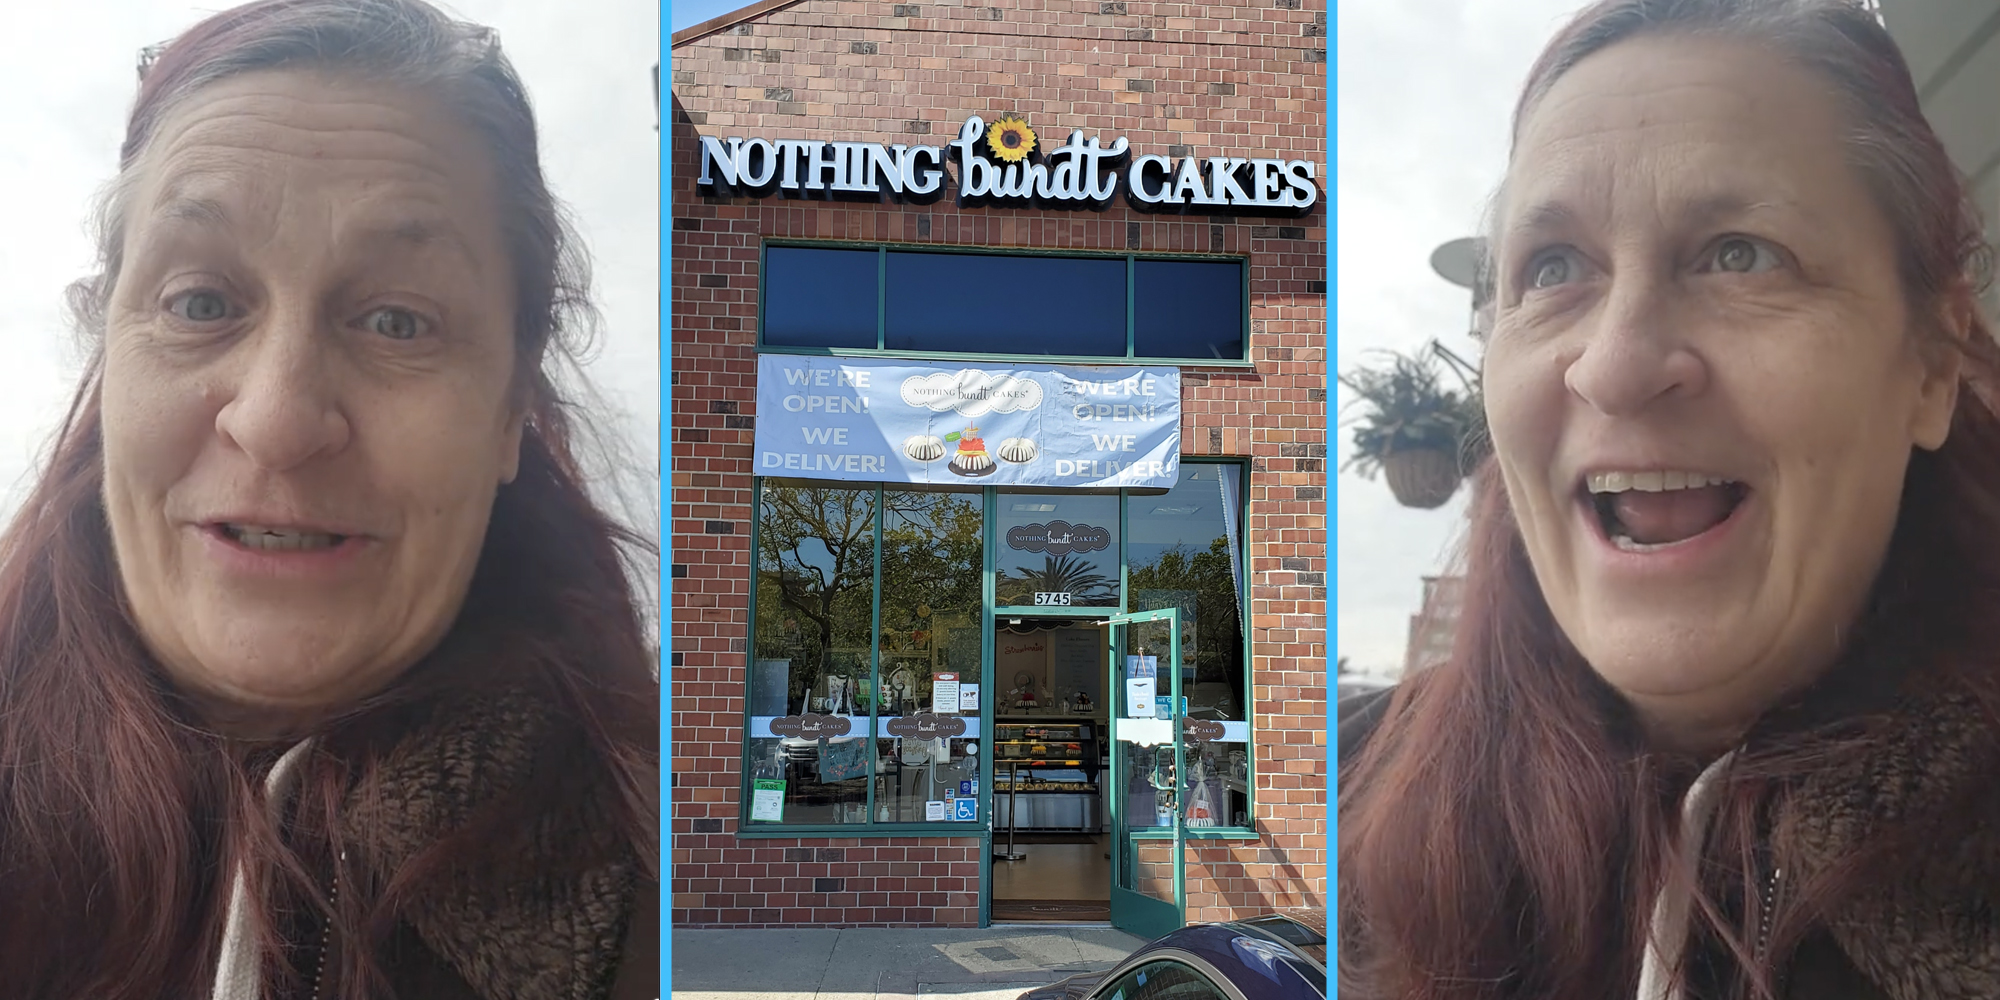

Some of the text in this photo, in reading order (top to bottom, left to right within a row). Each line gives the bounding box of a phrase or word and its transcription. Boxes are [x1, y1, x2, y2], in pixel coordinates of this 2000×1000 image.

[698, 115, 1317, 208] NOTHING bundt CAKES
[784, 368, 871, 388] WE'RE
[913, 388, 956, 397] NOTHING
[958, 382, 993, 401] bundt
[782, 395, 870, 414] OPEN!
[1072, 403, 1155, 422] OPEN!
[802, 427, 849, 446] WE
[1091, 434, 1137, 452] WE
[762, 451, 886, 473] DELIVER!
[1055, 459, 1172, 478] DELIVER!
[1047, 530, 1074, 544] bundt
[1036, 593, 1070, 605] 5745
